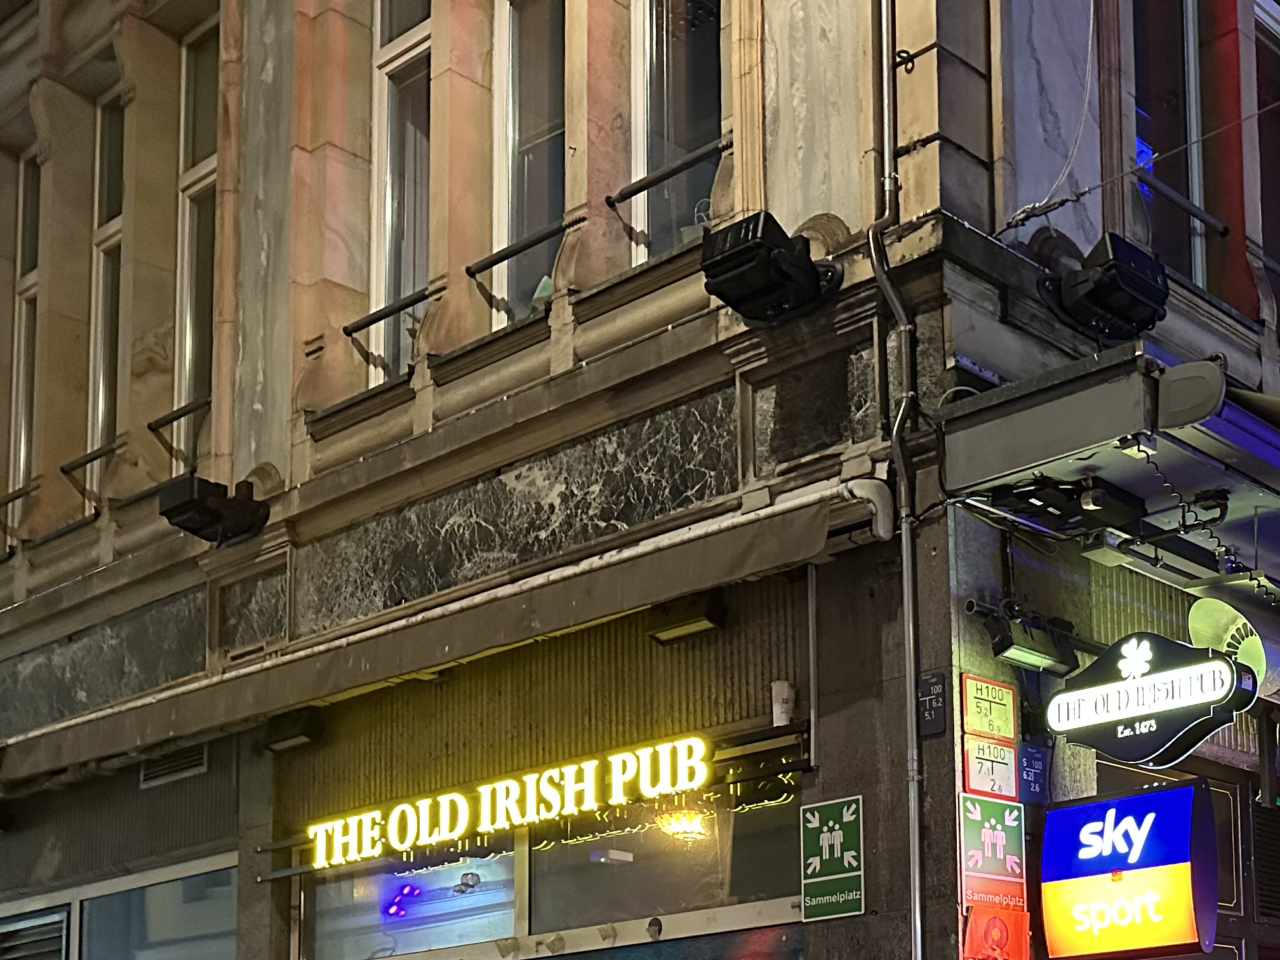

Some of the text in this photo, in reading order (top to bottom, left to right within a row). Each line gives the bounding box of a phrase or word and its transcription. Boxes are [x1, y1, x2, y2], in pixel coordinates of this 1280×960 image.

[931, 684, 942, 695] 100
[1055, 668, 1226, 724] THE OLD IRISH PUB
[976, 701, 989, 717] 5.2
[309, 736, 710, 869] THE OLD IRISH PUB
[1077, 807, 1157, 865] sky
[803, 887, 861, 908] Sammelplatz
[966, 889, 1024, 906] Sammelplatz
[1071, 888, 1164, 938] sport
